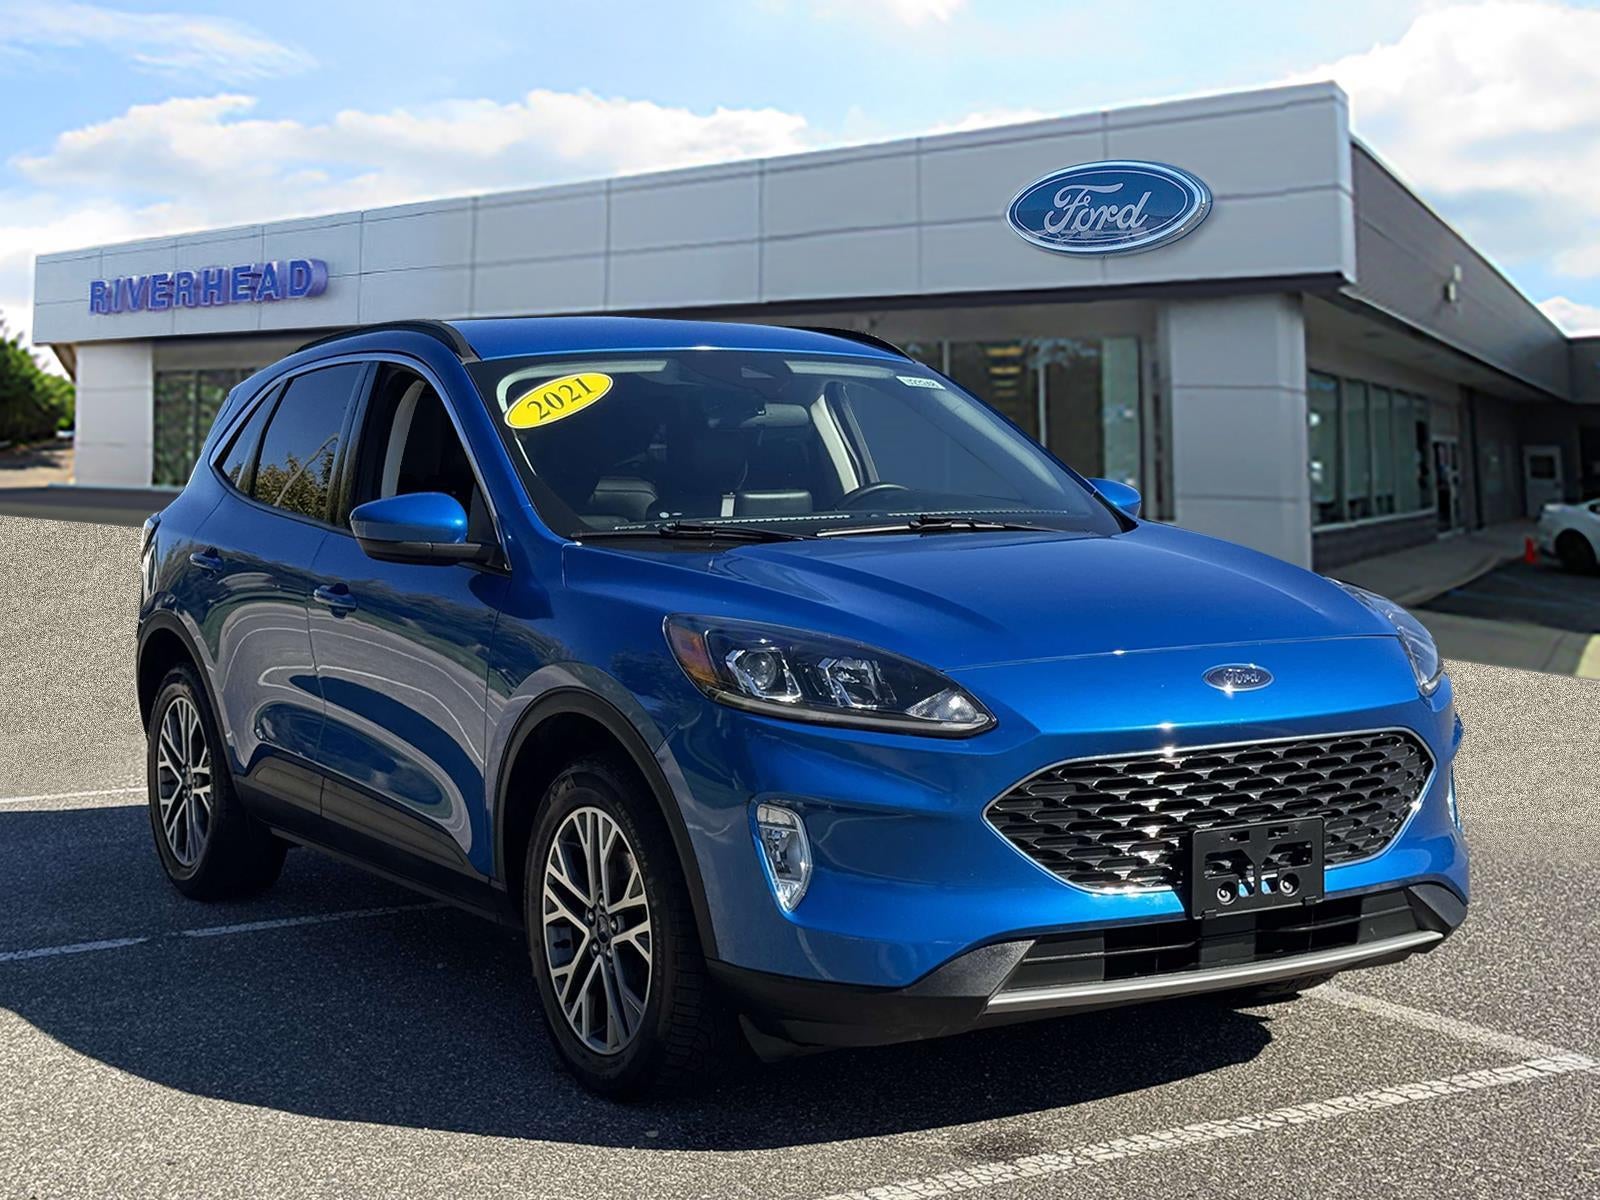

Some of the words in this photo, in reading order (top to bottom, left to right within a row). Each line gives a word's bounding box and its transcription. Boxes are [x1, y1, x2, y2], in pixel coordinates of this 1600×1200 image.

[1043, 182, 1152, 234] Ford
[89, 258, 318, 315] RIVERHEAD
[527, 378, 597, 420] 2021
[1222, 668, 1261, 685] Ford
